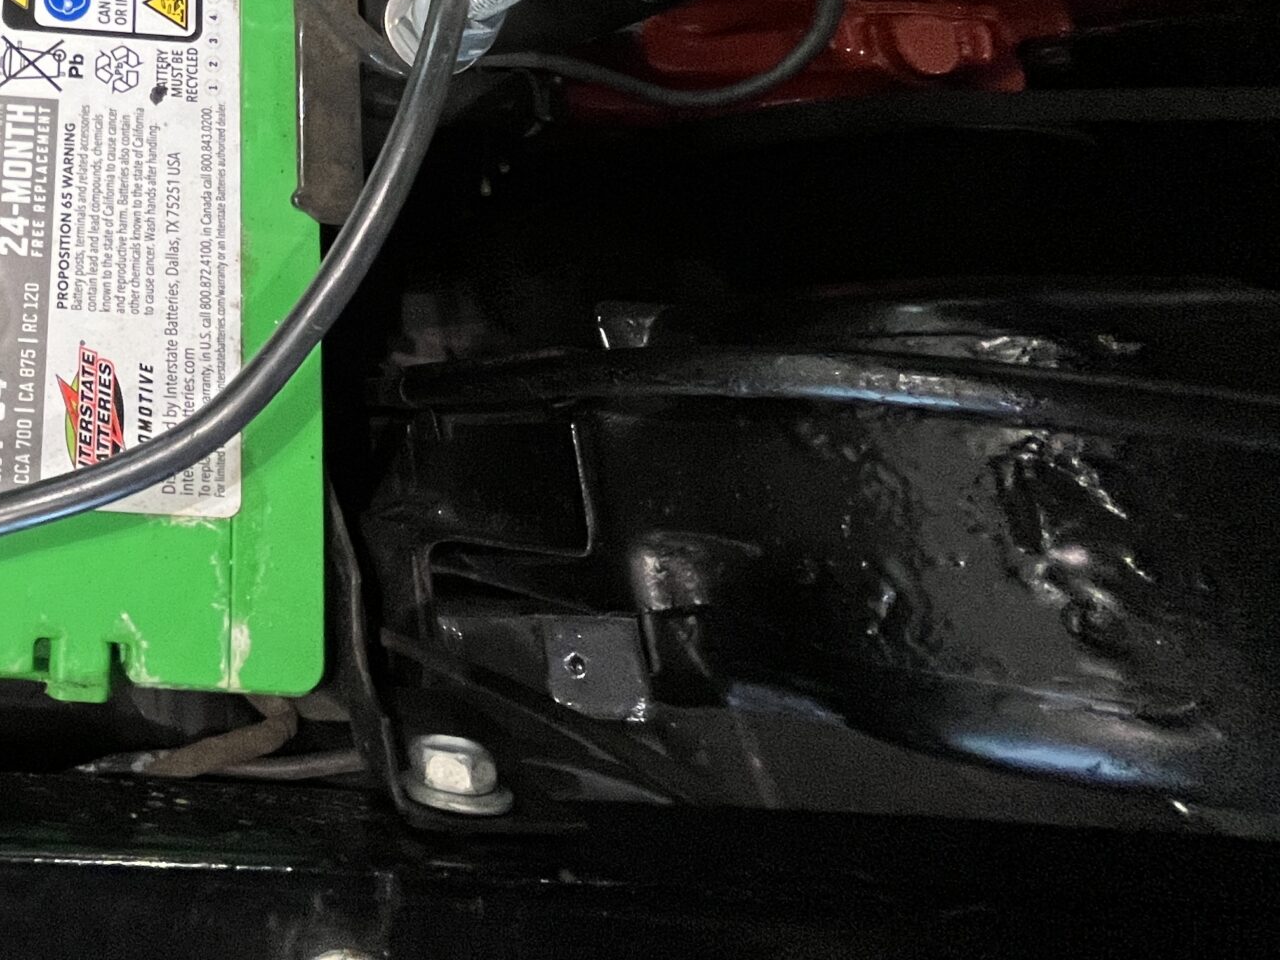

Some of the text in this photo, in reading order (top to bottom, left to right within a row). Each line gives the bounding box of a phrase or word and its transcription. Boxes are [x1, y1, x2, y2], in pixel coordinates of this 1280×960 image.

[98, 0, 110, 24] CAN
[115, 8, 126, 25] OR
[68, 52, 84, 78] Pb
[114, 61, 122, 75] Pb
[156, 48, 168, 87] ATTERY
[171, 49, 183, 97] MUST BE
[186, 47, 197, 102] RECYCLED
[216, 101, 225, 126] dealer.
[200, 105, 212, 172] 800.843.0200.
[216, 127, 225, 166] authorized
[30, 105, 51, 257] FREE REPLACEMENT
[166, 151, 180, 175] USA
[200, 173, 211, 189] call
[166, 178, 179, 217] 75251
[216, 168, 225, 200] Batteries
[56, 122, 75, 309] PROPOSITION 65 WARNING
[71, 104, 89, 310] Battery posts, terminals and related accessories
[85, 113, 103, 311] contain lead and lead compounds, chemicals
[99, 108, 117, 312] known to the state of California to cause cancer
[113, 114, 130, 313] and reproductive harm. Batteries also contain
[128, 107, 144, 314] other chemicals known to the state of California
[144, 122, 160, 315] to cause cancer. Wash hands after handling.
[165, 219, 179, 233] TX
[200, 190, 211, 225] Canada
[216, 202, 225, 238] Interstate
[200, 226, 211, 235] in
[218, 240, 225, 249] an
[165, 236, 181, 276] Dallas,
[199, 238, 213, 309] 800.872.4100,
[164, 279, 180, 335] Batteries,
[199, 311, 211, 327] call
[199, 329, 211, 349] U.S.
[199, 351, 211, 361] in
[13, 282, 39, 484] CCA 700 CA 875 RC 120
[163, 338, 177, 398] Interstate
[78, 351, 95, 466] TERSTATE
[96, 362, 111, 462] ATTERIES
[137, 362, 153, 444] OMOTIVE
[162, 401, 180, 417] by
[215, 450, 225, 481] limited
[198, 484, 210, 497] To
[215, 483, 225, 497] For
